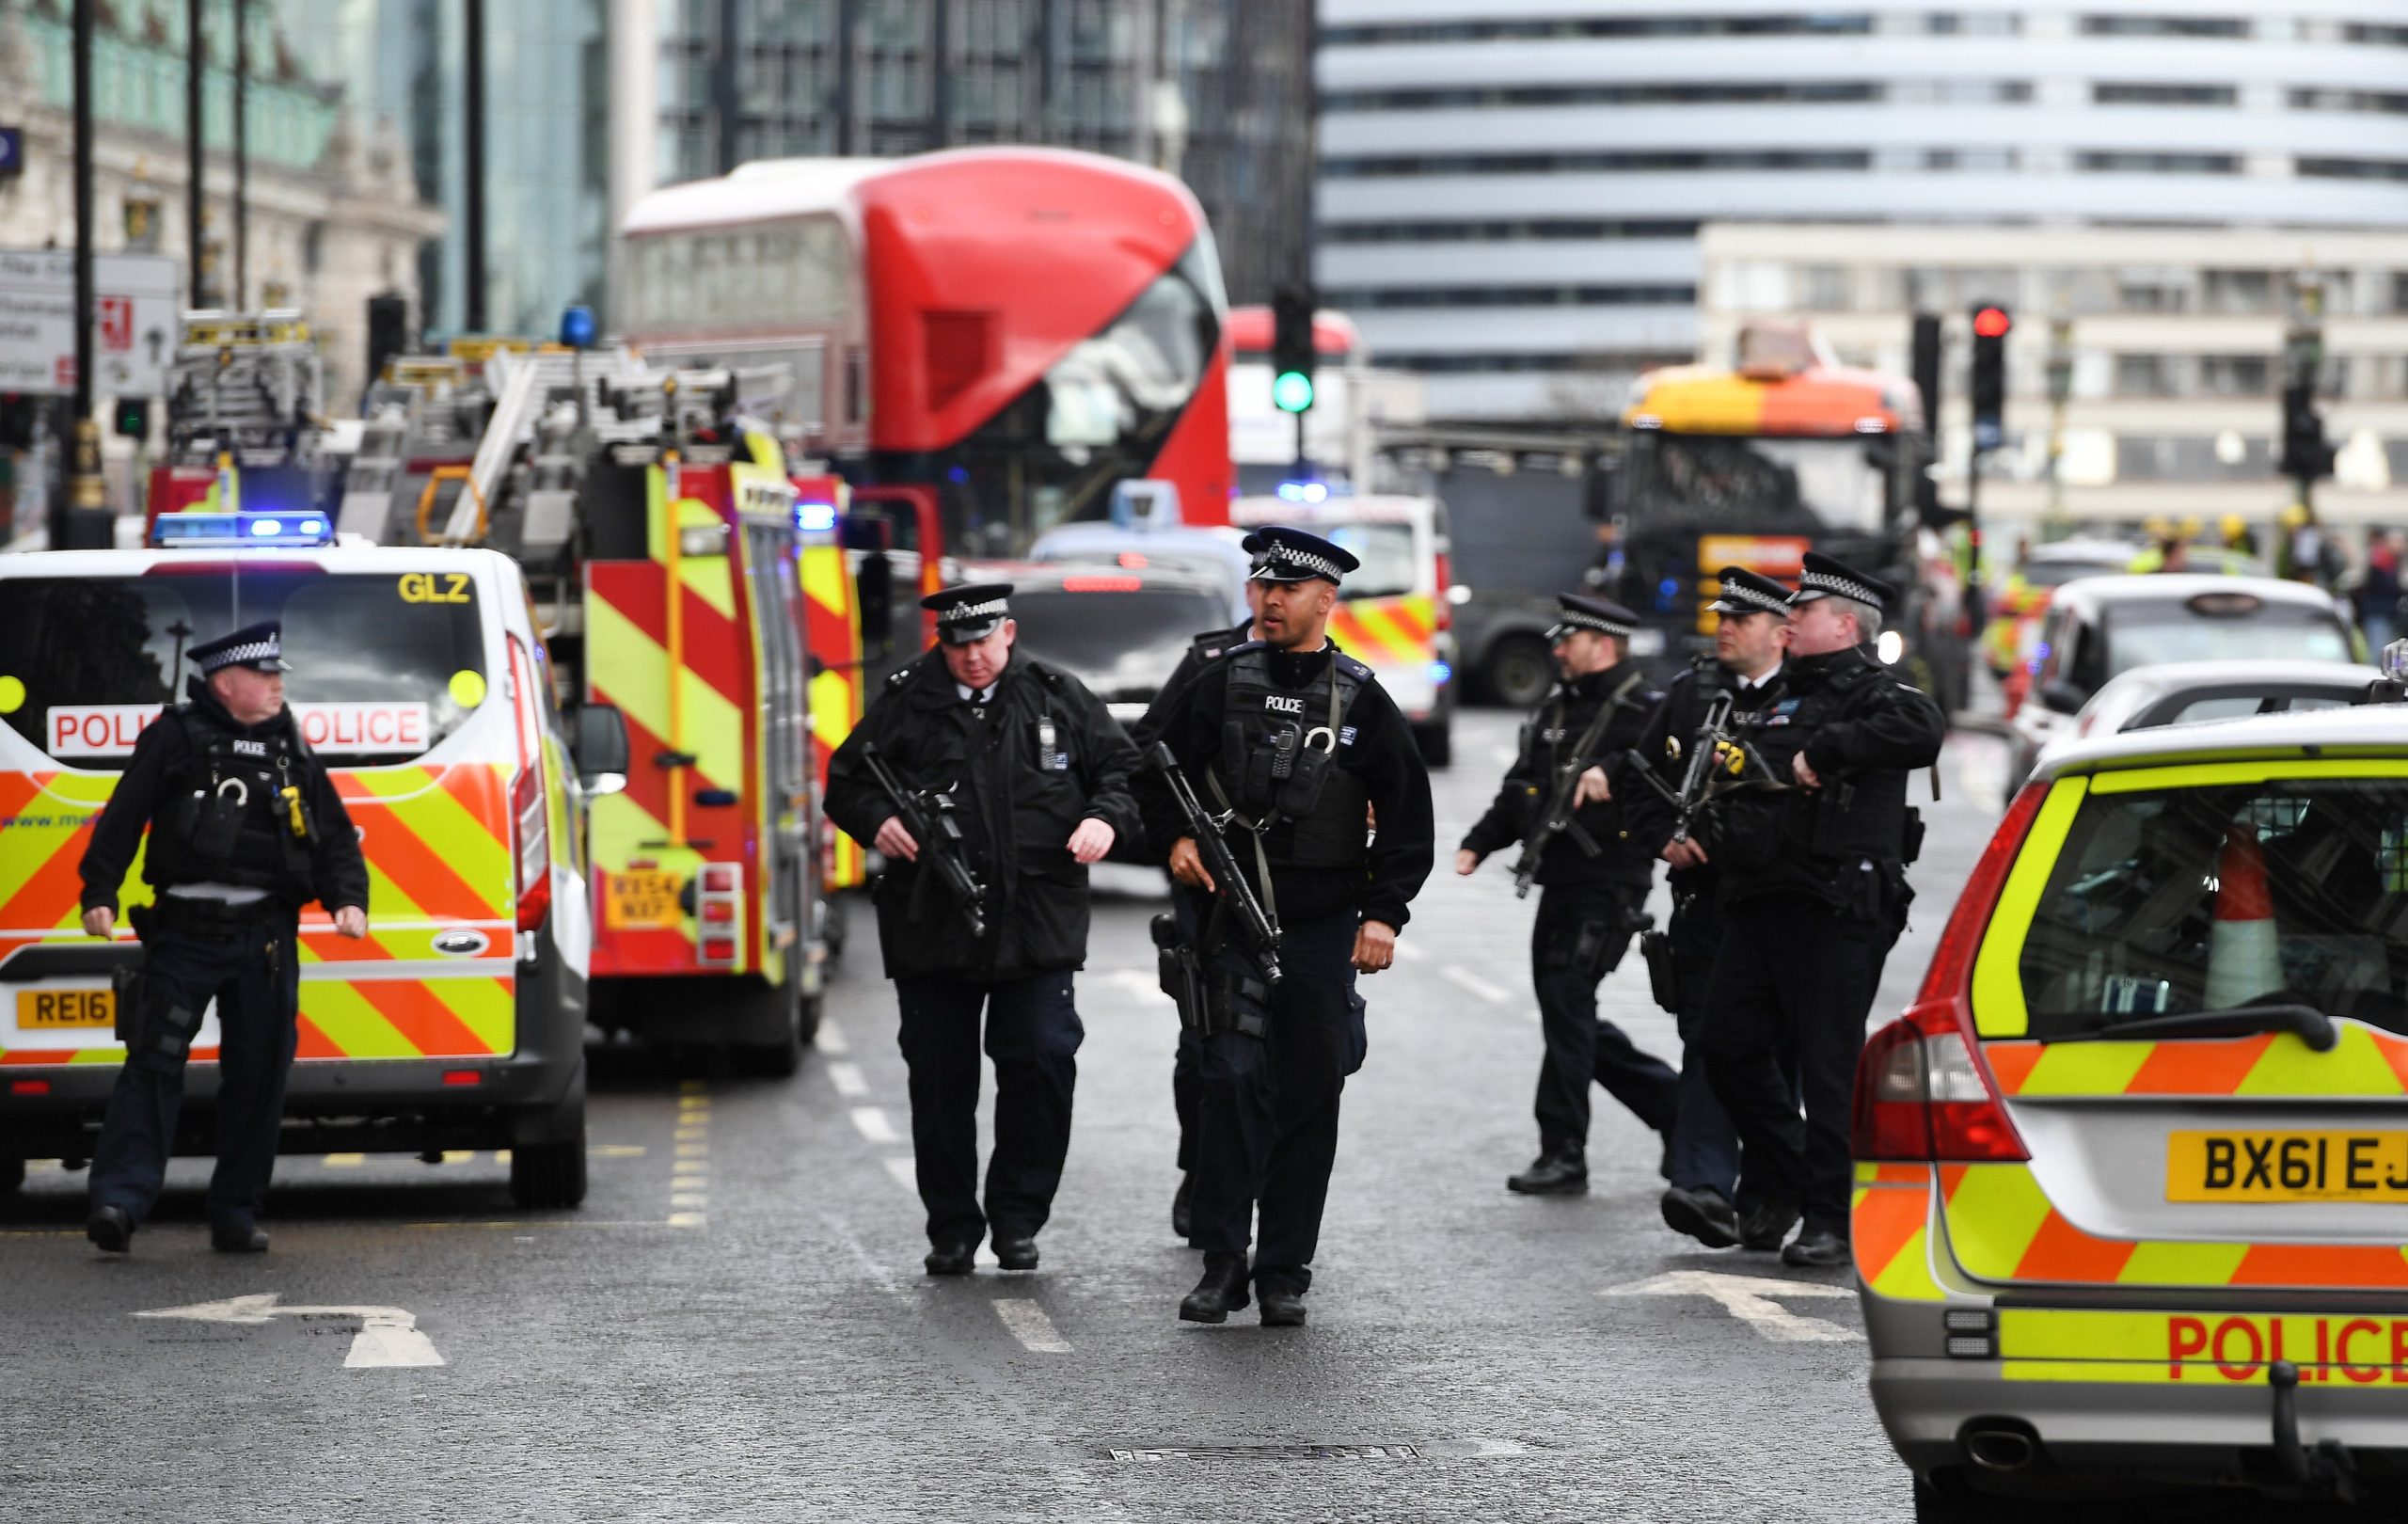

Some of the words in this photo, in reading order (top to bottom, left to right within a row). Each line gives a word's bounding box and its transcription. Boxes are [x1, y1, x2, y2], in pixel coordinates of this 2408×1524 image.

[398, 572, 470, 603] GLZ
[1264, 695, 1304, 713] POLICE
[56, 712, 164, 748] POLI
[302, 709, 420, 744] OLICE
[233, 739, 266, 756] POLICE
[37, 992, 107, 1022] RE16
[2204, 1138, 2327, 1189] BX61
